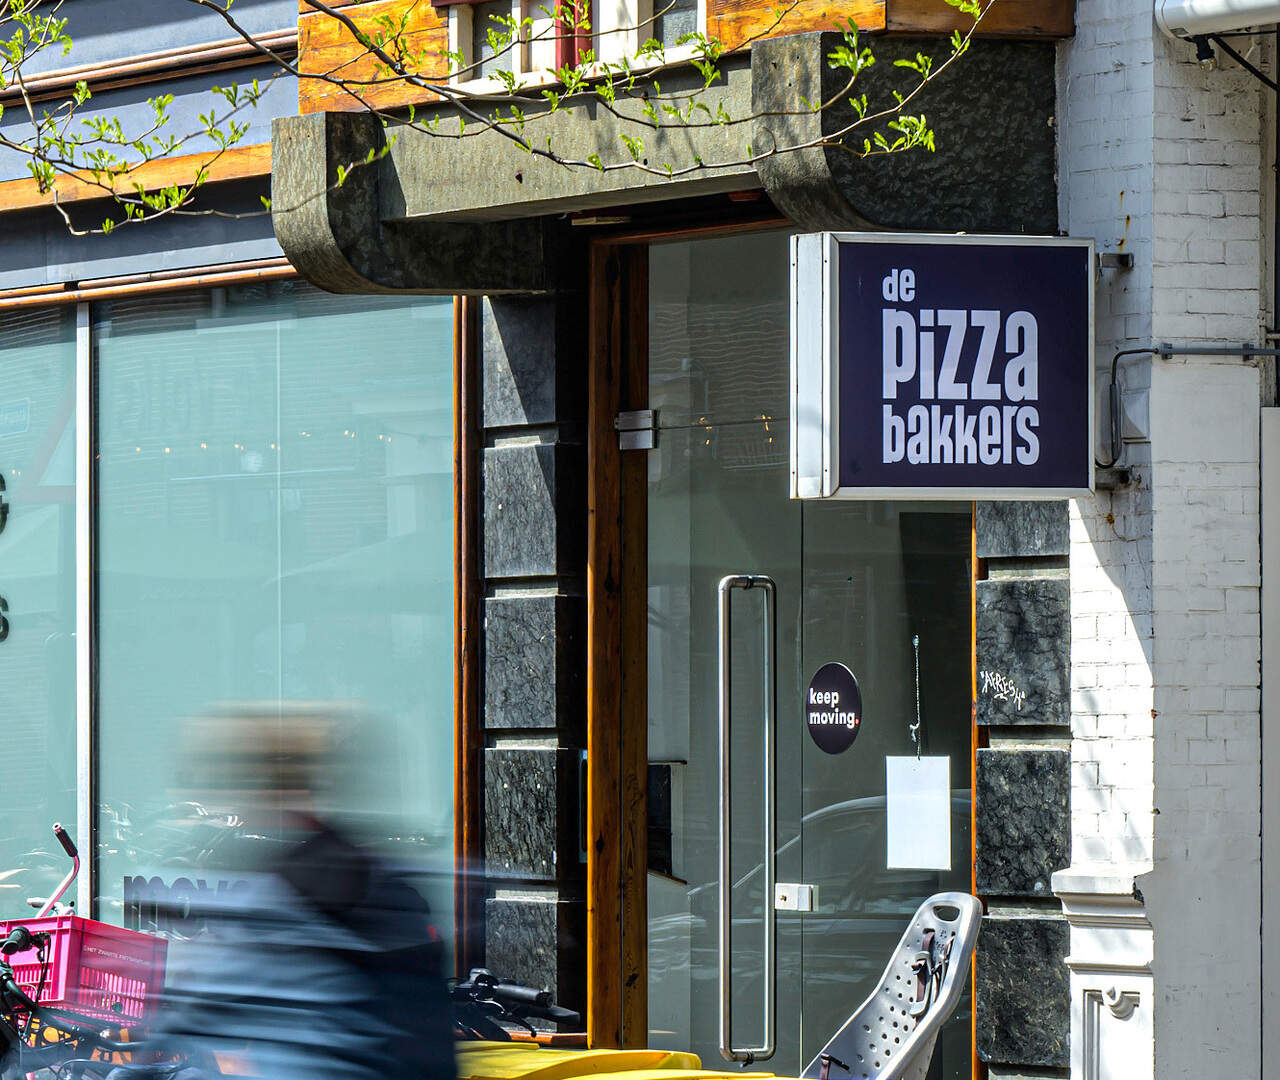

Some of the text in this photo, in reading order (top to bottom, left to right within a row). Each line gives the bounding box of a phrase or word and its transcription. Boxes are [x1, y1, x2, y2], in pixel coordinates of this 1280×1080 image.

[882, 268, 915, 302] de
[882, 308, 1039, 403] pizza
[882, 404, 1040, 466] bakkers
[809, 687, 839, 709] keep
[809, 708, 860, 729] moving.
